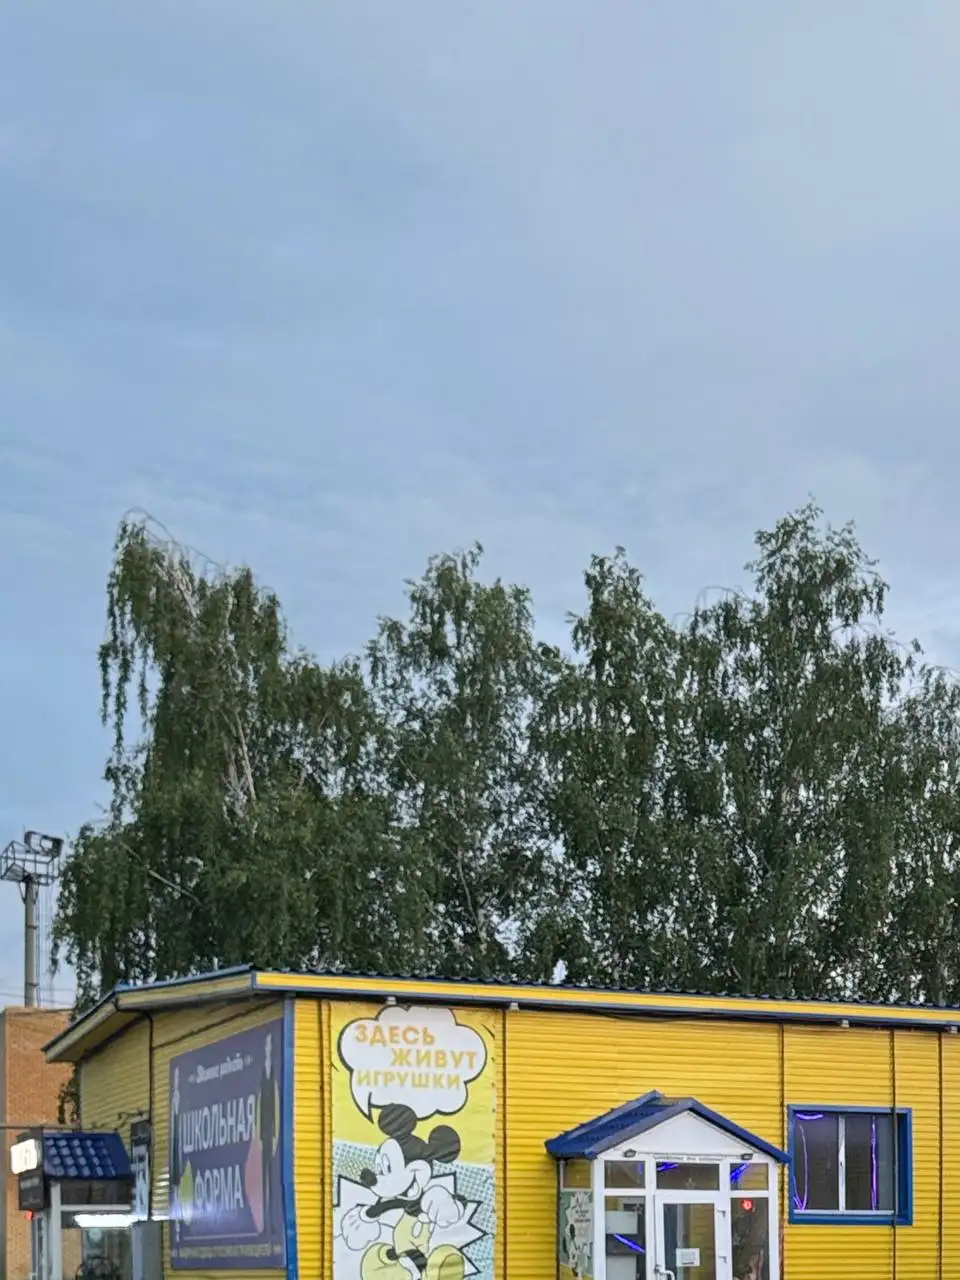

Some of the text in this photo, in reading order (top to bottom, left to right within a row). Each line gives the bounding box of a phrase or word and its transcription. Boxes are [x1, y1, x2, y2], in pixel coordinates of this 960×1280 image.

[355, 1023, 436, 1046] ЗДЕСЬ
[390, 1047, 477, 1069] ЖИВУТ
[356, 1069, 460, 1090] ИГРУШКИ
[182, 1094, 256, 1154] ШКОЛЬНАЯ
[194, 1164, 244, 1212] ФОРМА
